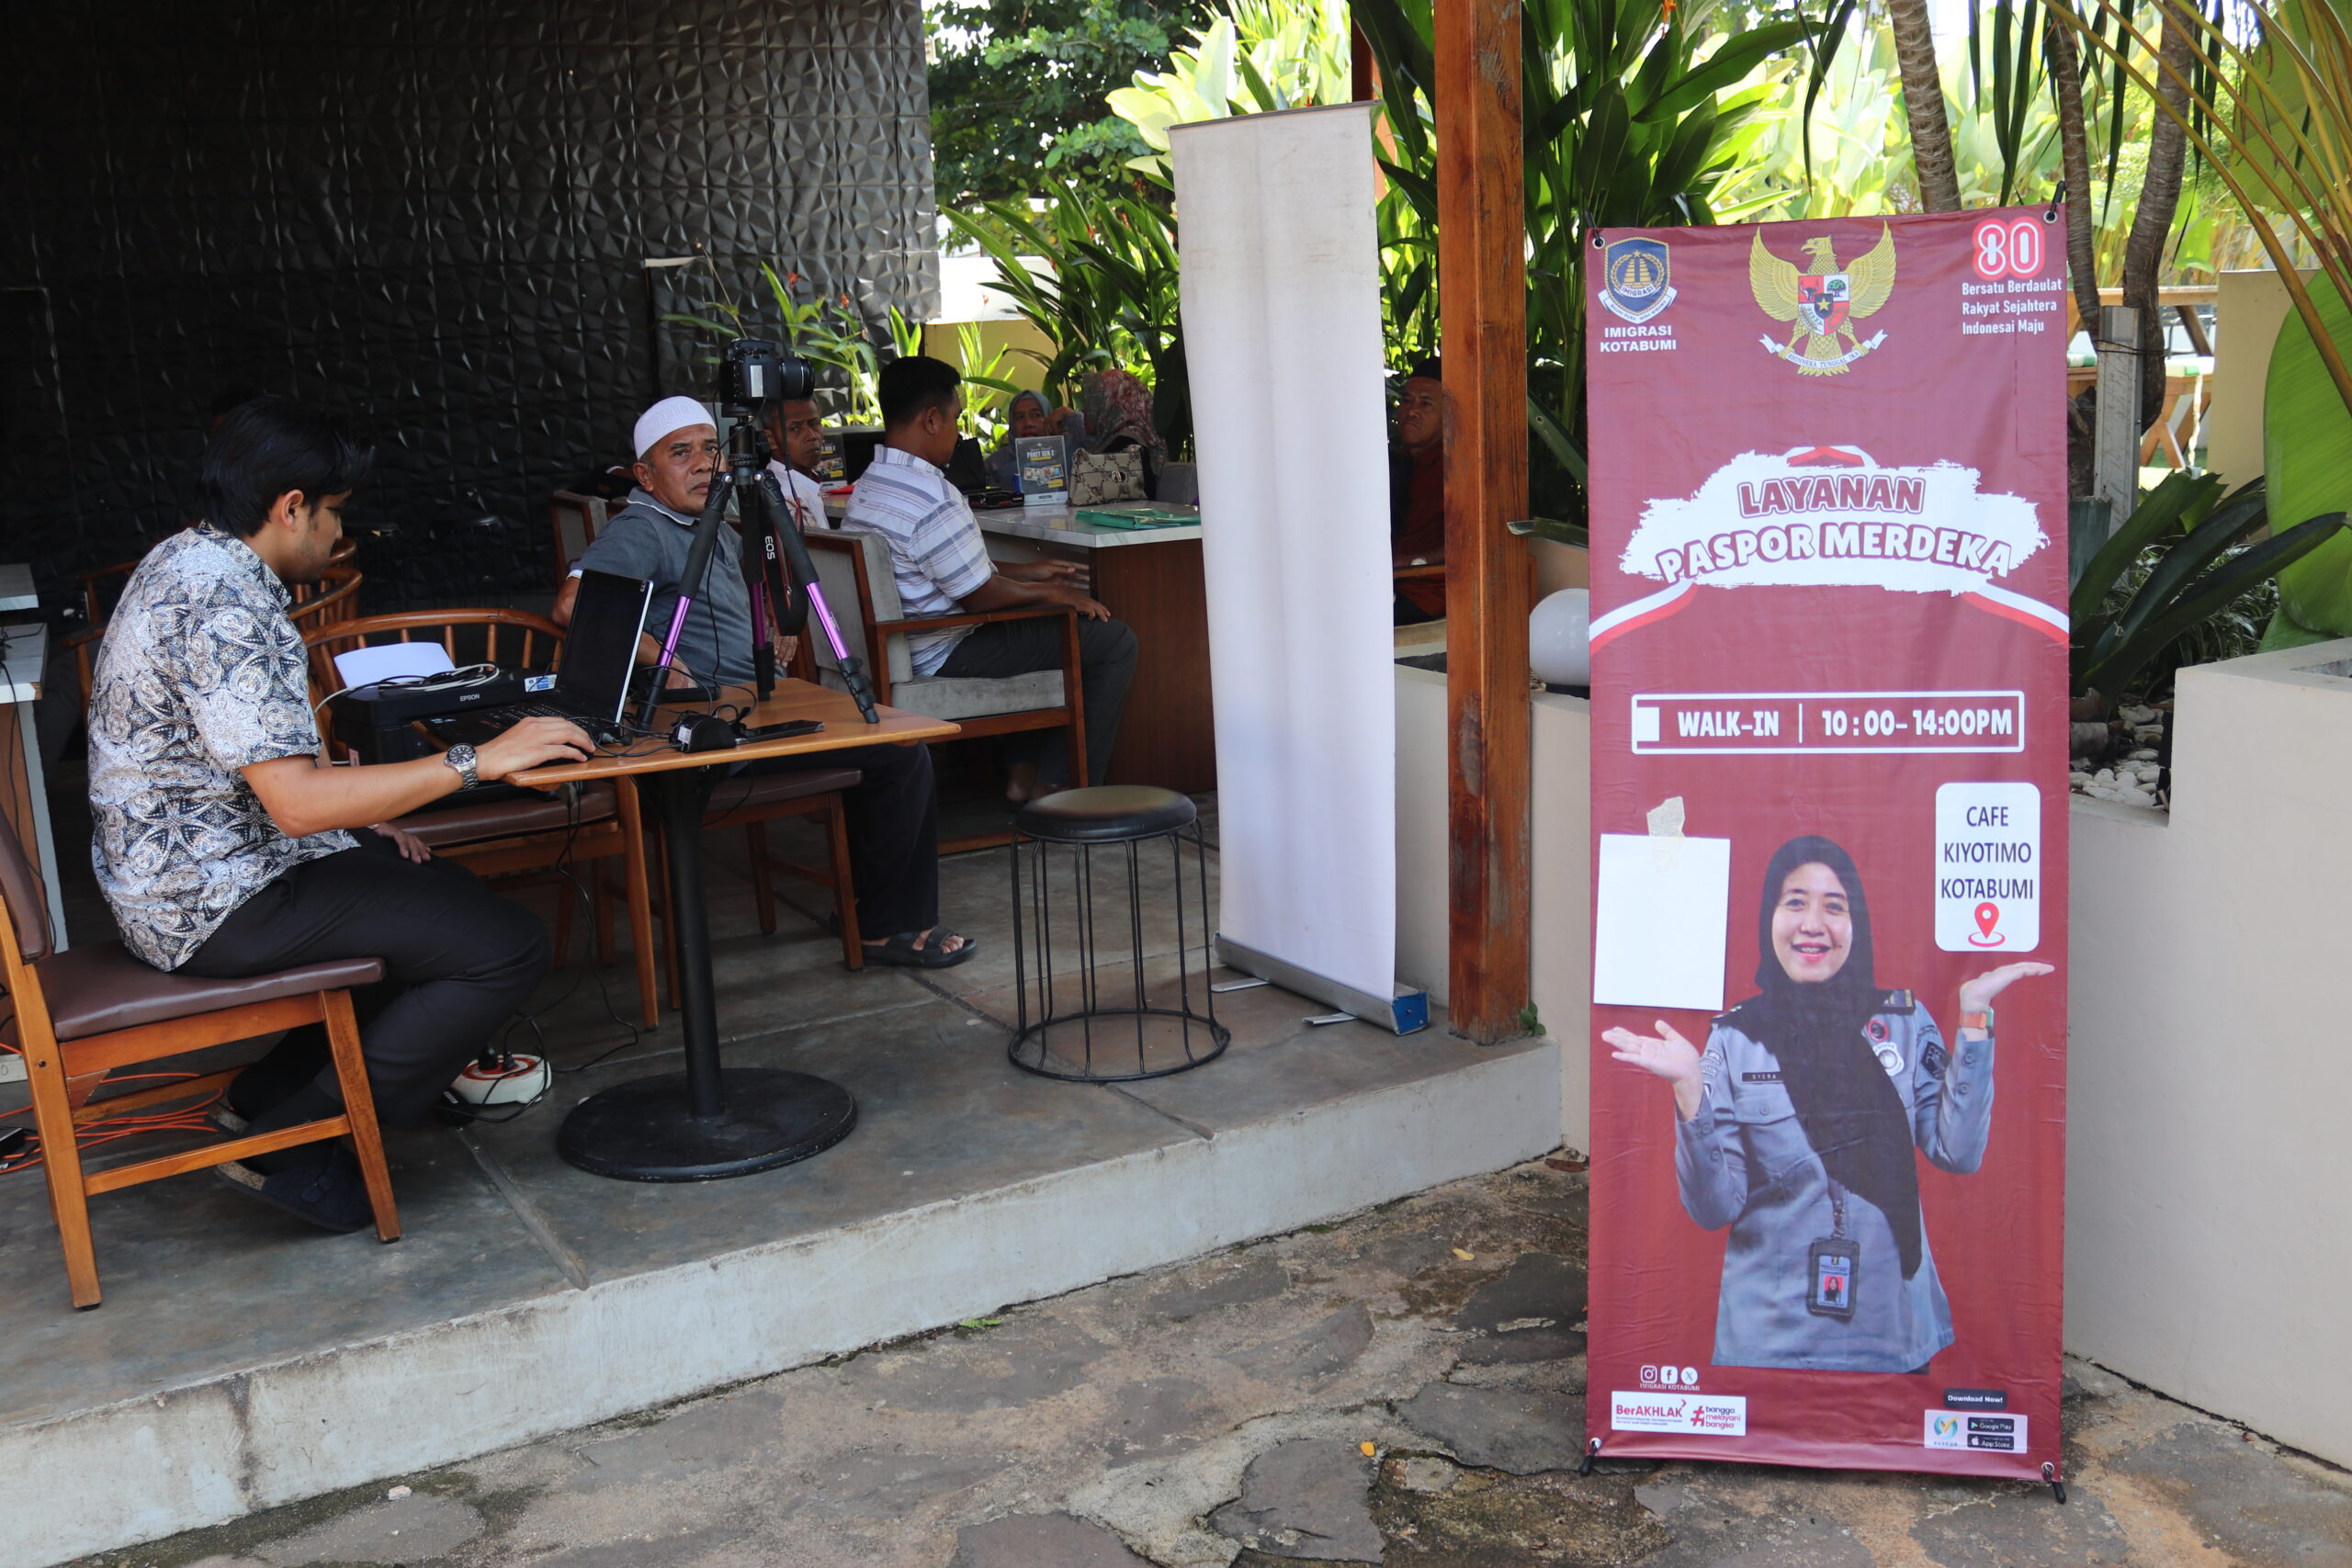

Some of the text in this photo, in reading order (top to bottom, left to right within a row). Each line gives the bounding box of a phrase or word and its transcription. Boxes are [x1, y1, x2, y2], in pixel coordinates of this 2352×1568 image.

[1976, 220, 2041, 276] 80
[1962, 278, 2063, 295] Bersatu Berdaulat
[1962, 299, 2058, 318] Rakyat Sejahtera
[1604, 325, 1672, 338] IMIGRASI
[1962, 318, 2045, 334] Indonesai Maju
[1600, 340, 1677, 353] KOTABUMI
[1737, 473, 1926, 519] LAYANAN
[764, 536, 776, 560] EOS
[1655, 521, 2012, 586] PASPOR MERDEKA
[459, 694, 481, 702] EPSON
[1677, 710, 1780, 737] WALK-IN
[1966, 806, 2009, 827] CAFE
[1943, 841, 2032, 863] KIYOTIMO
[1940, 878, 2034, 899] KOTABUMI
[1668, 1383, 1701, 1392] KOTABUMI
[1947, 1394, 2004, 1404] Download Now!
[1615, 1404, 1683, 1419] BerAKHLAK
[1705, 1413, 1741, 1423] melayani
[1705, 1421, 1735, 1430] bangsa
[1979, 1422, 2012, 1431] Google Play
[1982, 1439, 2011, 1449] App Store
